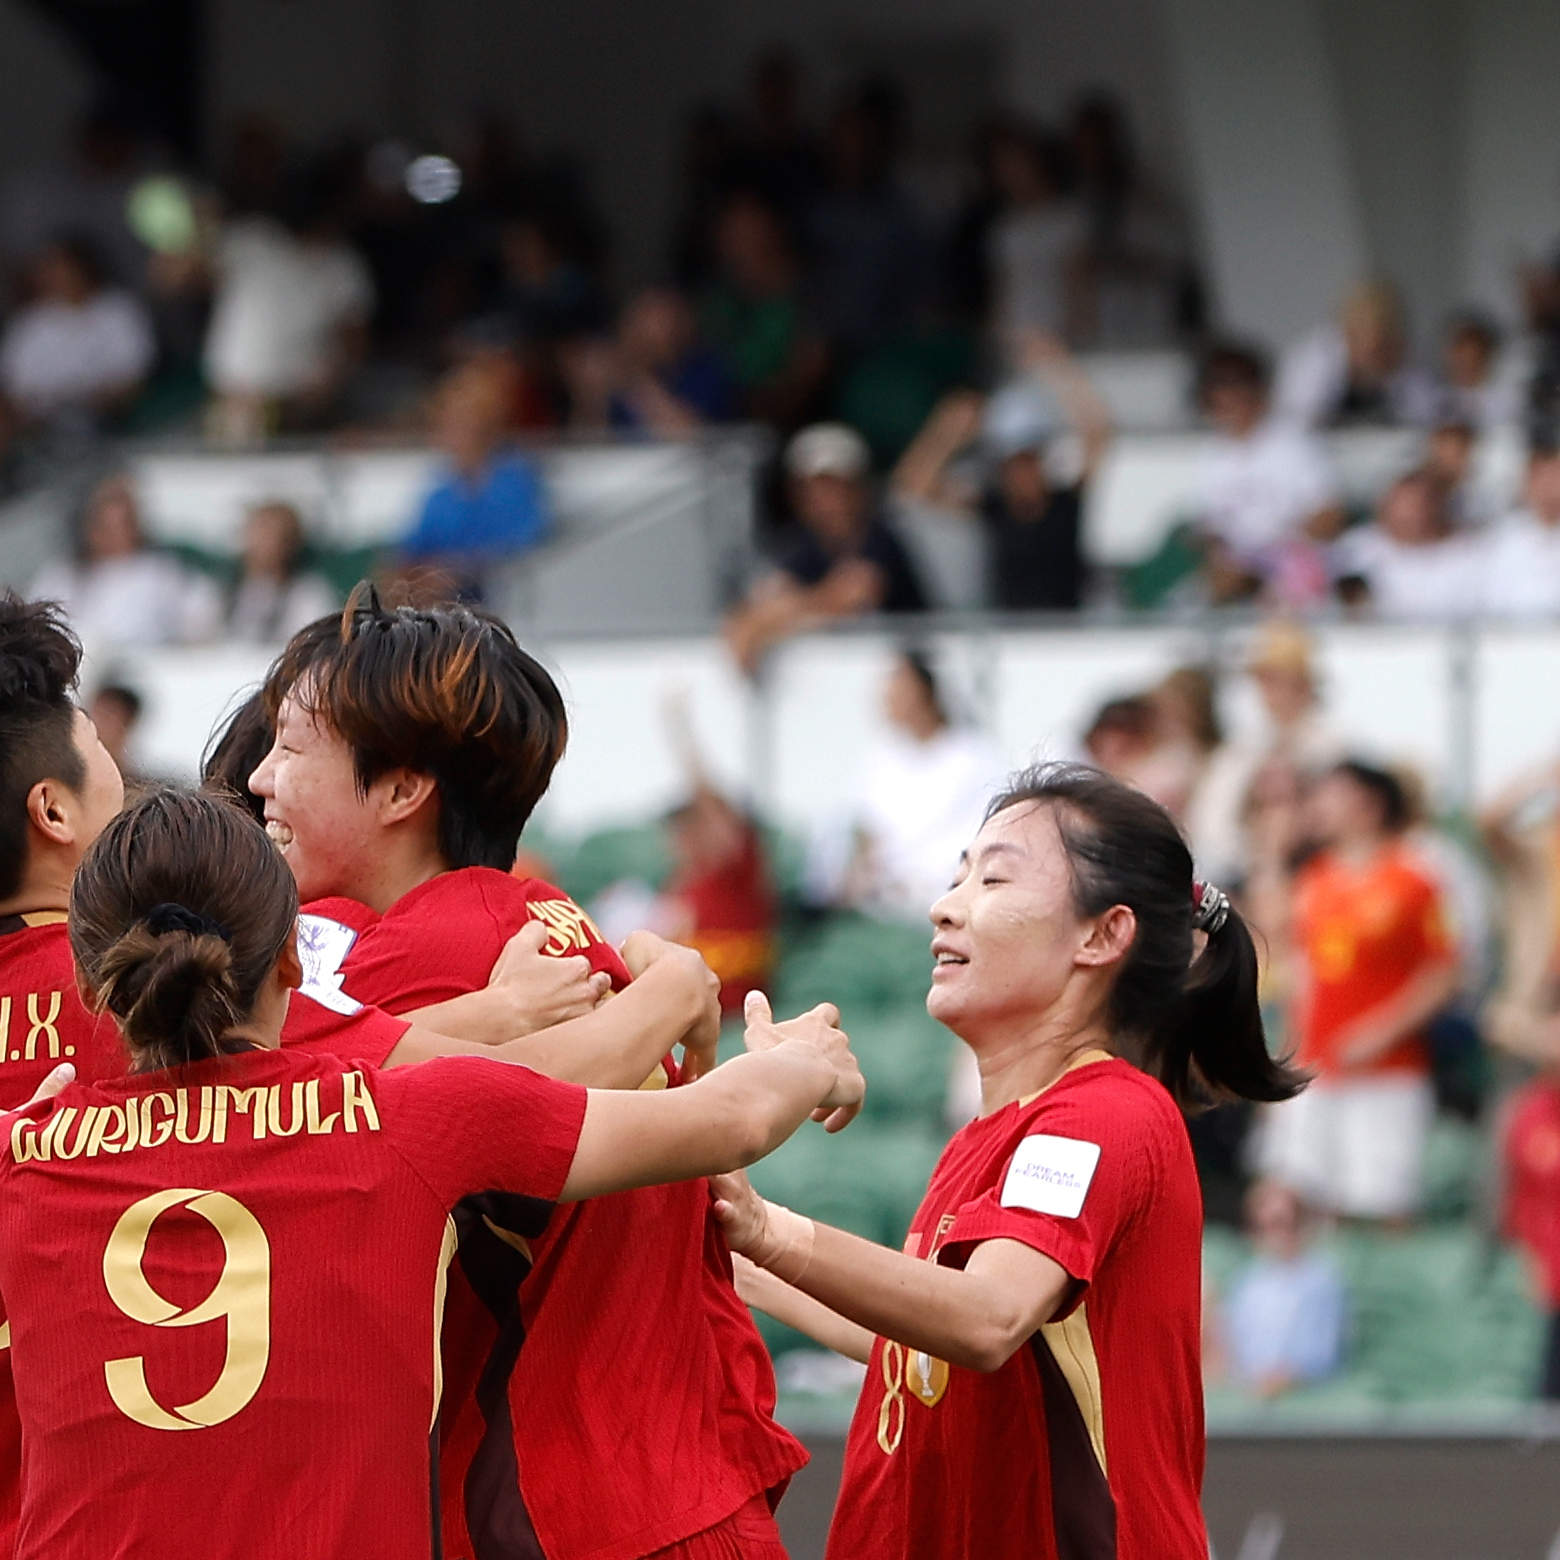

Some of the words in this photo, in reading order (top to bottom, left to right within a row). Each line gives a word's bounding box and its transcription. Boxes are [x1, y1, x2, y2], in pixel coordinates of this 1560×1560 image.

[10, 1068, 382, 1165] WURIGUMULA
[1026, 1162, 1076, 1181] DREAM
[102, 1187, 272, 1431] 9
[876, 1340, 906, 1455] 8
